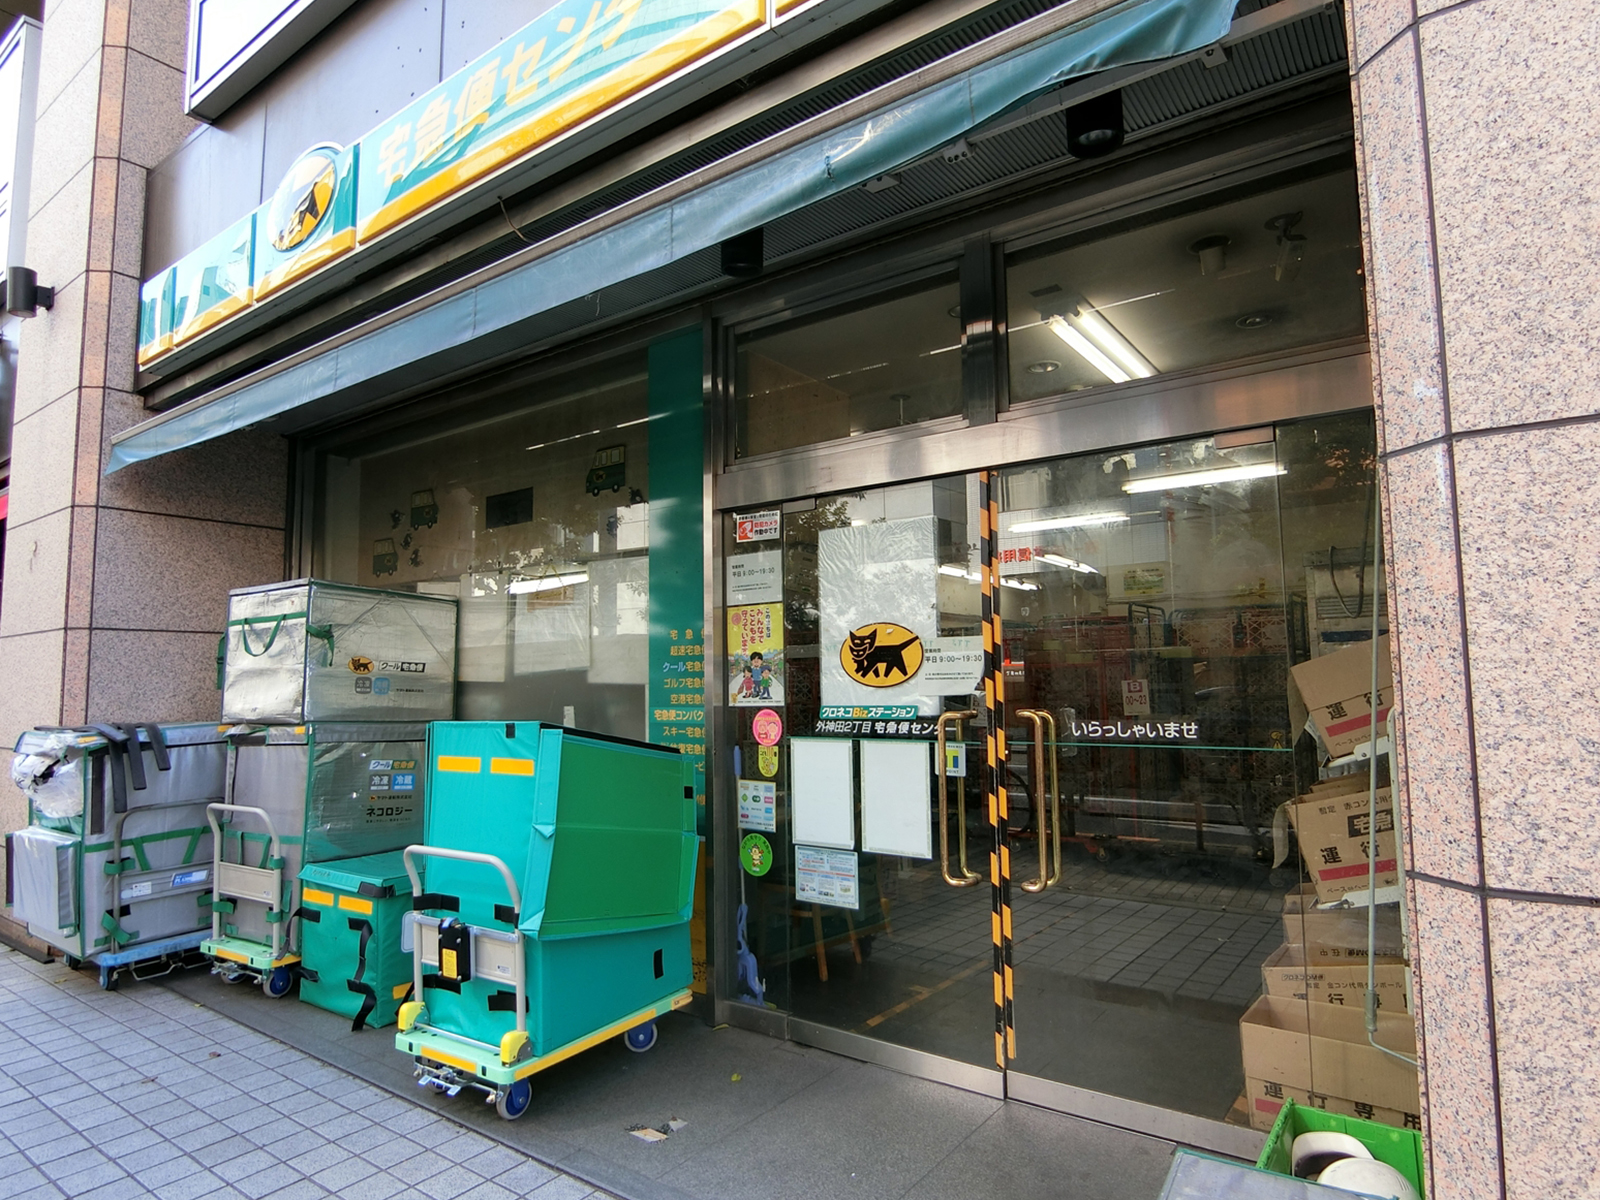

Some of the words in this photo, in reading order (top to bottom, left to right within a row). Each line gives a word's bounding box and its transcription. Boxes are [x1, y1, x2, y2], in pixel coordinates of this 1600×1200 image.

[670, 645, 704, 656] 超速宅急
[662, 661, 704, 673] クール宅急
[663, 677, 704, 689] ゴルフ宅急
[1131, 682, 1140, 691] B
[670, 693, 704, 705] 空港宅急
[653, 709, 704, 721] 宅急便コンパク
[821, 706, 915, 718] クロネコBizステーション
[815, 720, 872, 734] 外神田2丁目
[1071, 721, 1198, 738] いらっしゃいませ
[371, 775, 389, 785] 冷凍
[395, 774, 413, 785] 冷蔵
[366, 804, 413, 817] ネコロジー
